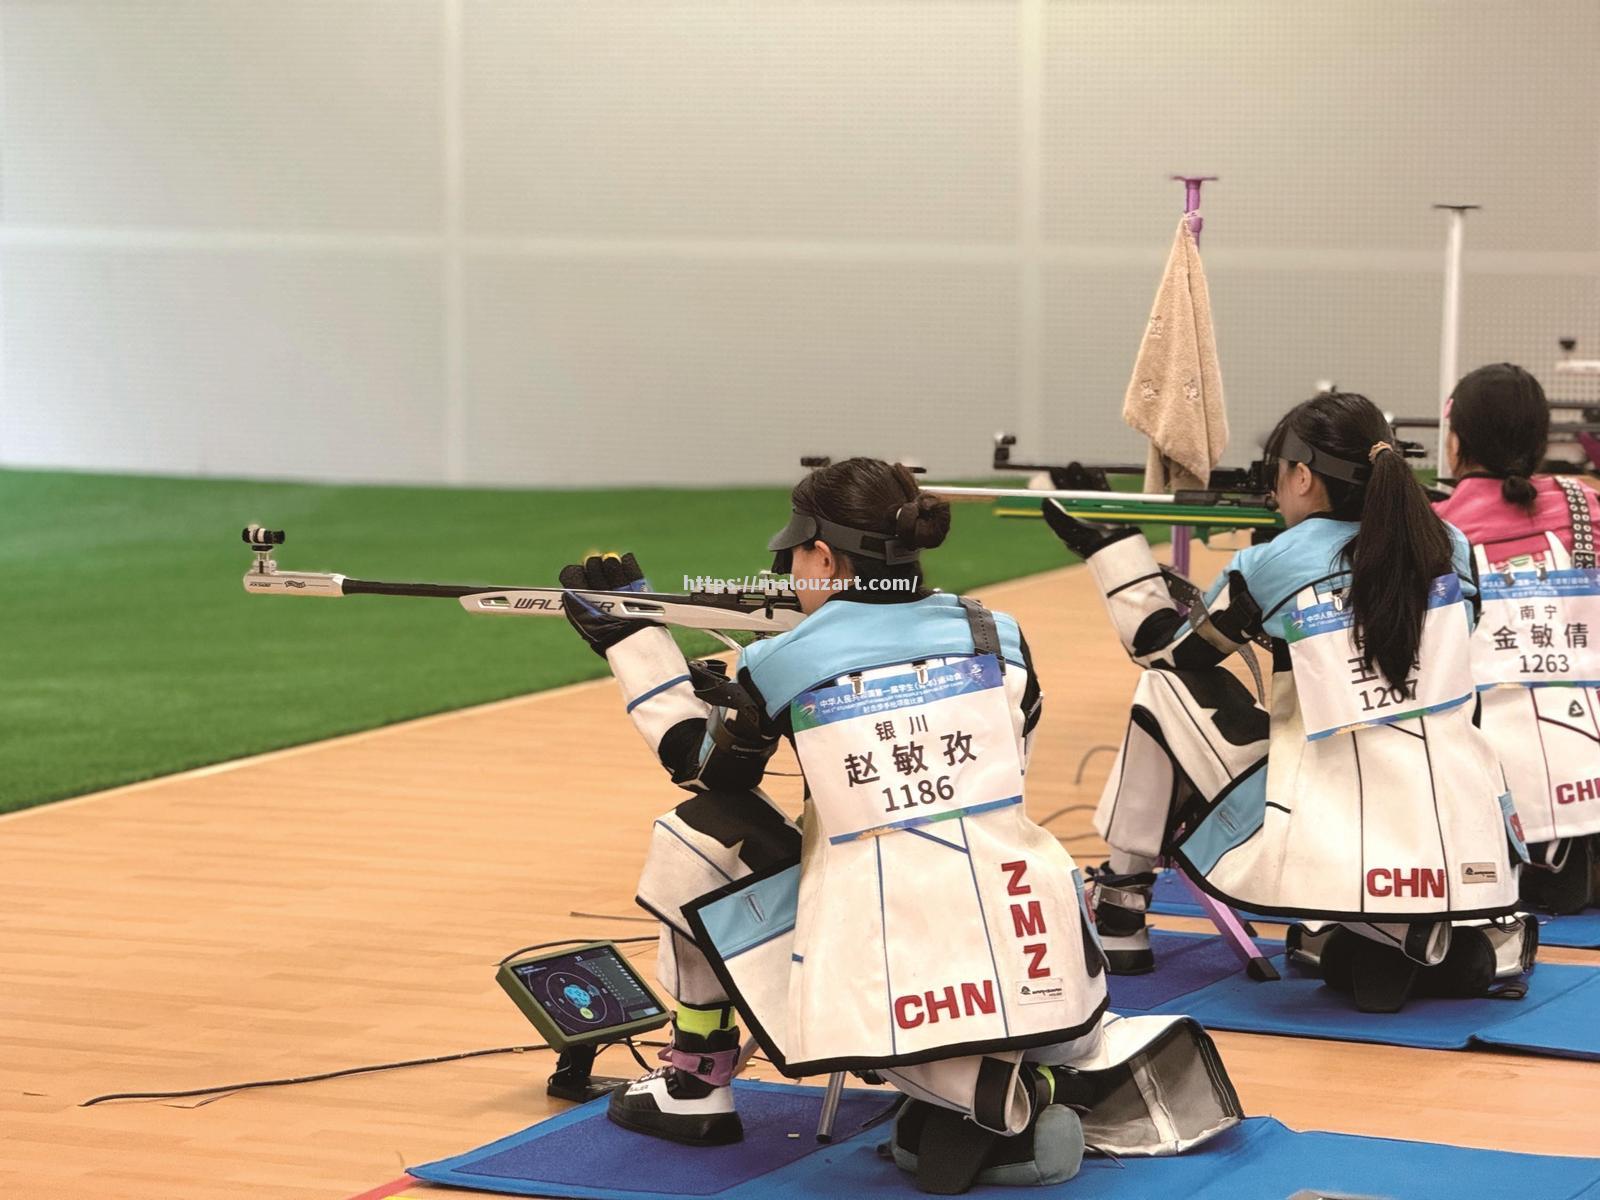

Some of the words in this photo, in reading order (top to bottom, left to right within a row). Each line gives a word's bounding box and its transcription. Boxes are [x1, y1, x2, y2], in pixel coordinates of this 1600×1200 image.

[1492, 623, 1588, 651] 金敏倩
[1519, 654, 1570, 673] 1263
[875, 715, 929, 742] 银川
[844, 731, 977, 787] 赵敏孜
[882, 776, 955, 812] 1186
[1366, 868, 1447, 898] CHN
[895, 979, 997, 1030] CHN
